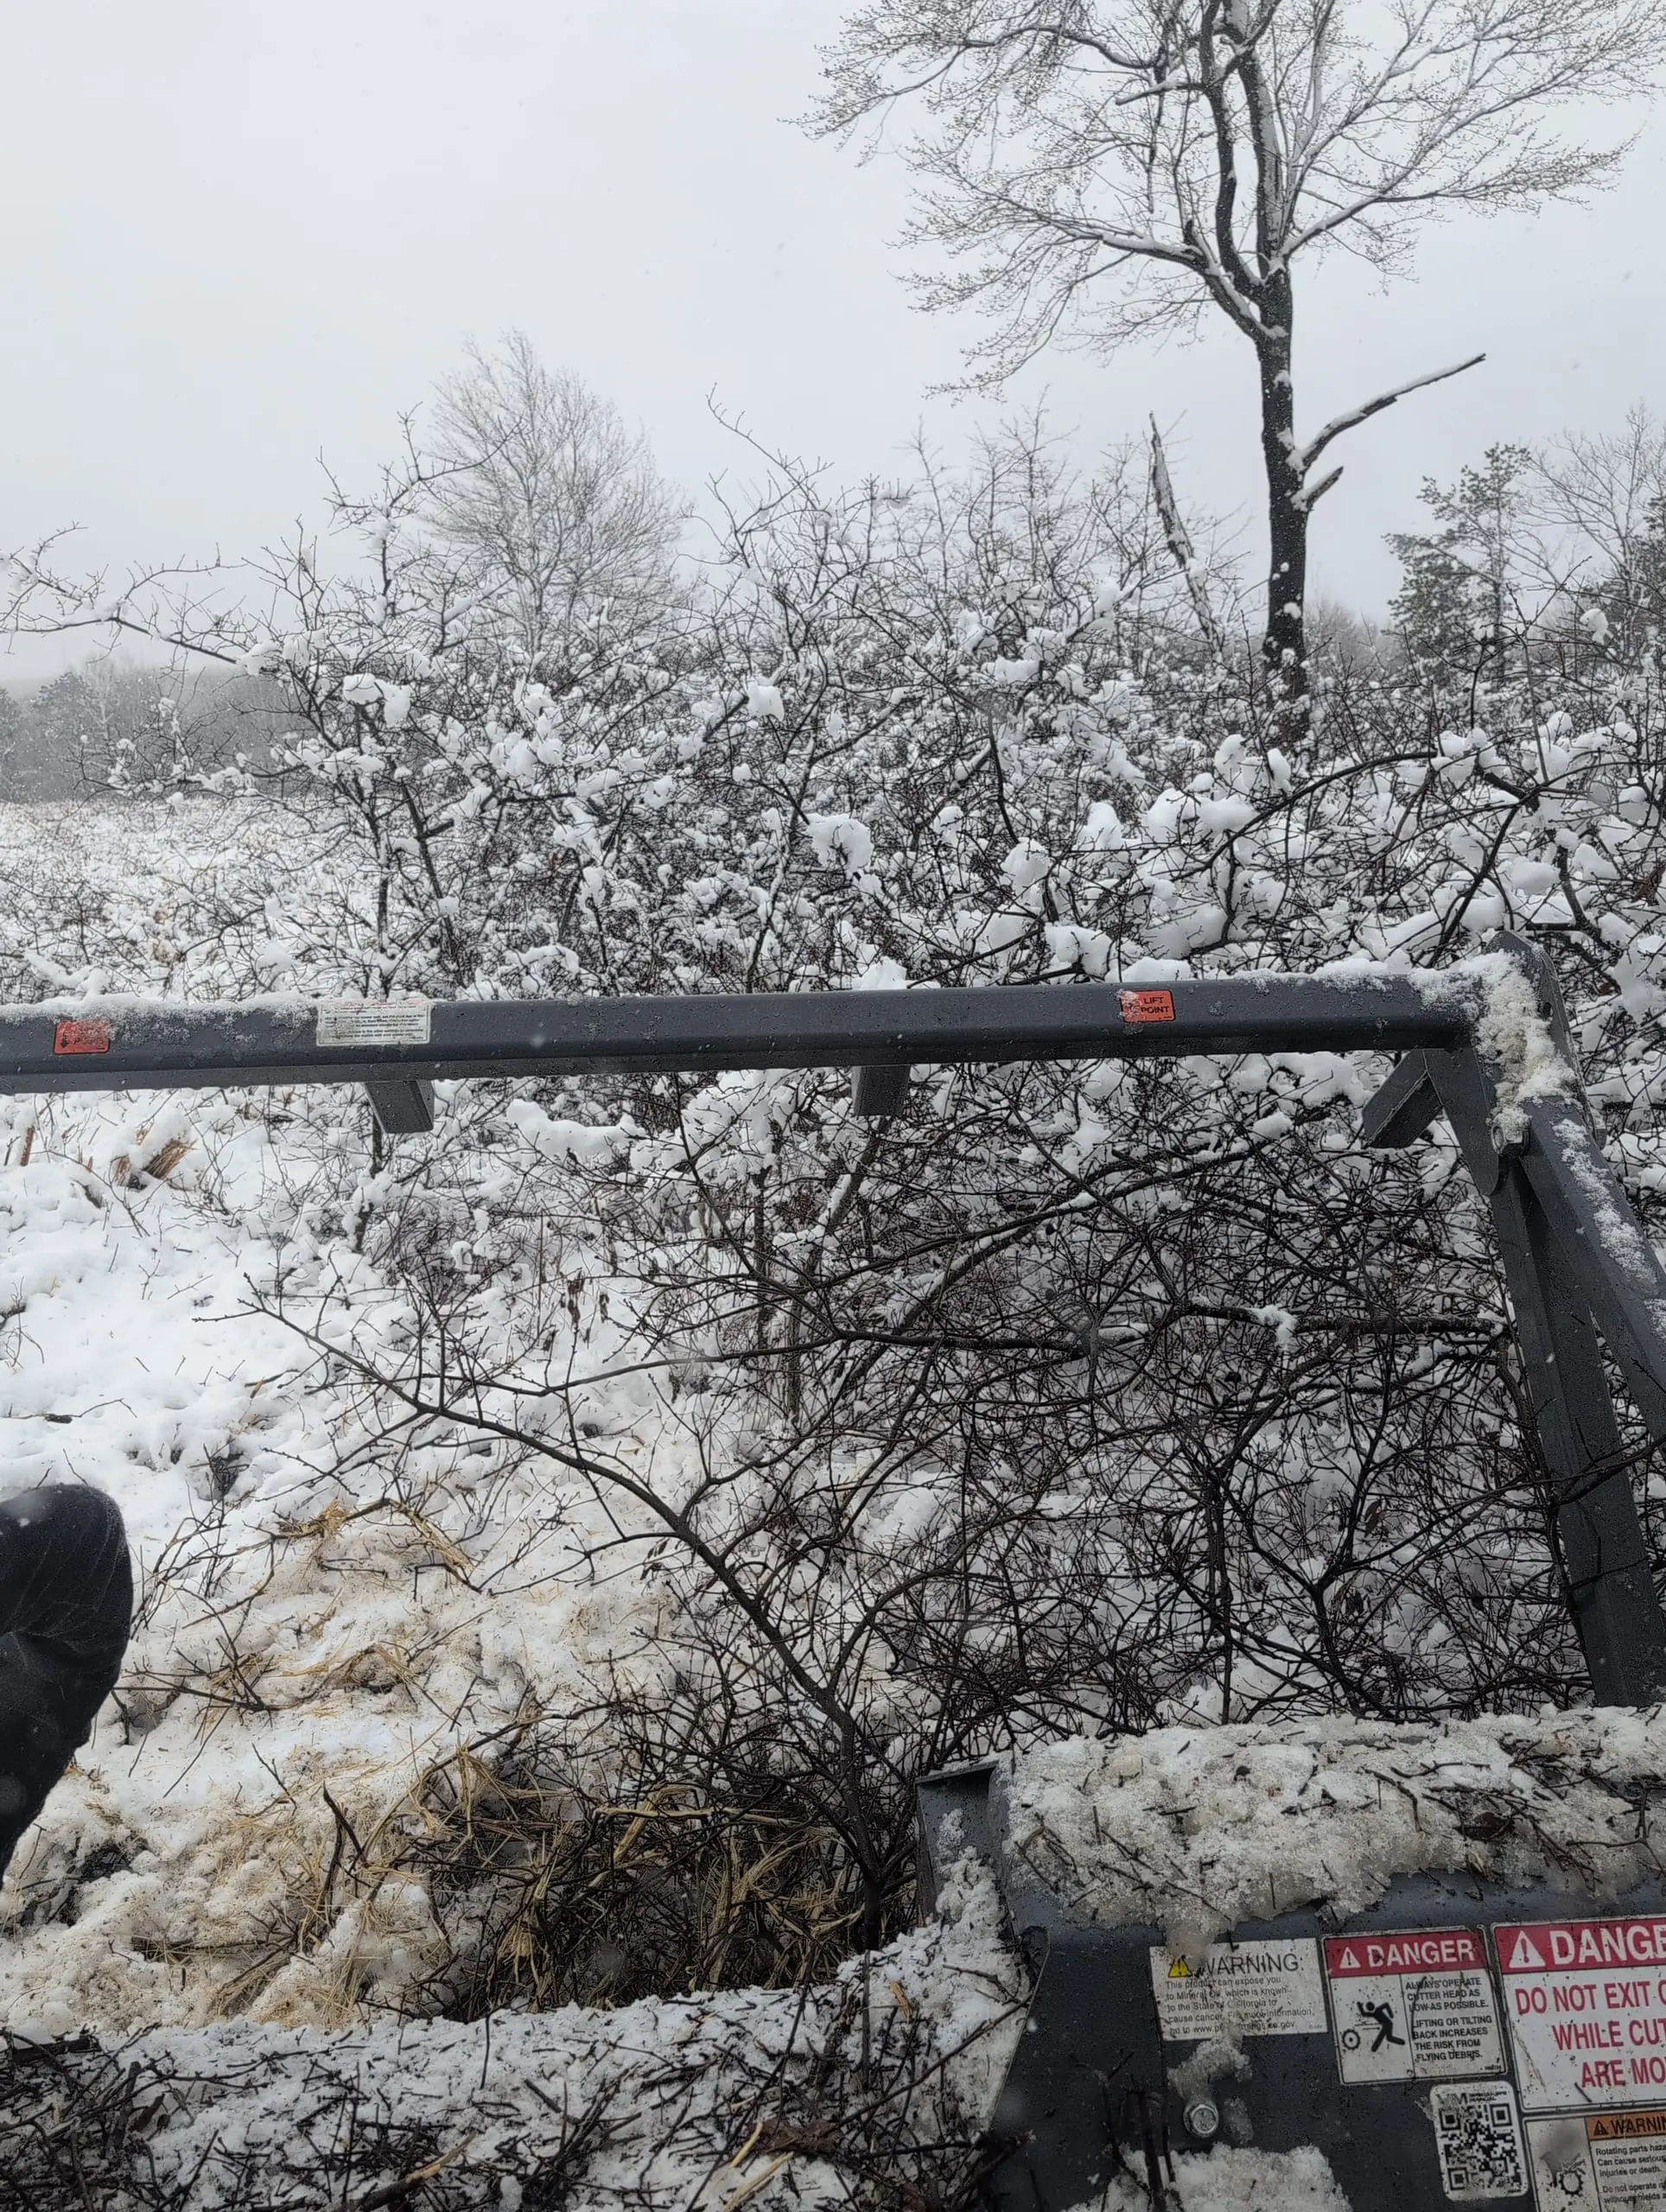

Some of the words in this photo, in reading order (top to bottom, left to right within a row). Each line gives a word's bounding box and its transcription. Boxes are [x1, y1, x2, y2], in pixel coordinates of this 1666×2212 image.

[1549, 1923, 1666, 1965] DANGE
[1367, 1939, 1475, 1967] DANGER
[1167, 1980, 1182, 1989] This
[1236, 1976, 1264, 1986] expose
[1267, 1976, 1281, 1985] you
[1406, 1979, 1441, 1990] ALWAYS
[1442, 1977, 1481, 1988] OPERATE
[1167, 1992, 1174, 2000] to
[1177, 1990, 1207, 1999] Mineral
[1225, 1987, 1250, 1997] which
[1262, 1986, 1286, 1996] known
[1408, 1991, 1441, 2001] CUTTER
[1443, 1990, 1467, 1999] HEAD
[1515, 1986, 1547, 2015] DO
[1553, 1985, 1597, 2012] NOT
[1604, 1980, 1650, 2009] EXIT
[1178, 2003, 1191, 2012] the
[1193, 2001, 1214, 2011] State
[1227, 1999, 1267, 2009] Clifornia
[1409, 2003, 1428, 2012] LOW
[1429, 2002, 1442, 2011] AS
[1444, 1999, 1489, 2010] POSSIBLE.
[1168, 2015, 1192, 2024] cause
[1413, 2018, 1444, 2028] LIFTING
[1446, 2018, 1459, 2026] OR
[1460, 2015, 1492, 2024] TILTING
[1413, 2031, 1438, 2040] BACK
[1440, 2027, 1488, 2037] INCREASES
[1552, 2020, 1625, 2050] WHILE
[1415, 2042, 1432, 2050] THE
[1434, 2040, 1453, 2049] RISK
[1456, 2039, 1480, 2048] FROM
[1417, 2052, 1447, 2062] FLYING
[1448, 2050, 1483, 2060] DEBRIS.
[1581, 2059, 1626, 2088] ARE
[1631, 2056, 1666, 2084] MO
[1596, 2146, 1628, 2156] Rotating
[1630, 2145, 1649, 2155] parts
[1602, 2185, 1613, 2194] Do
[1615, 2184, 1627, 2193] not
[1629, 2182, 1657, 2192] operate
